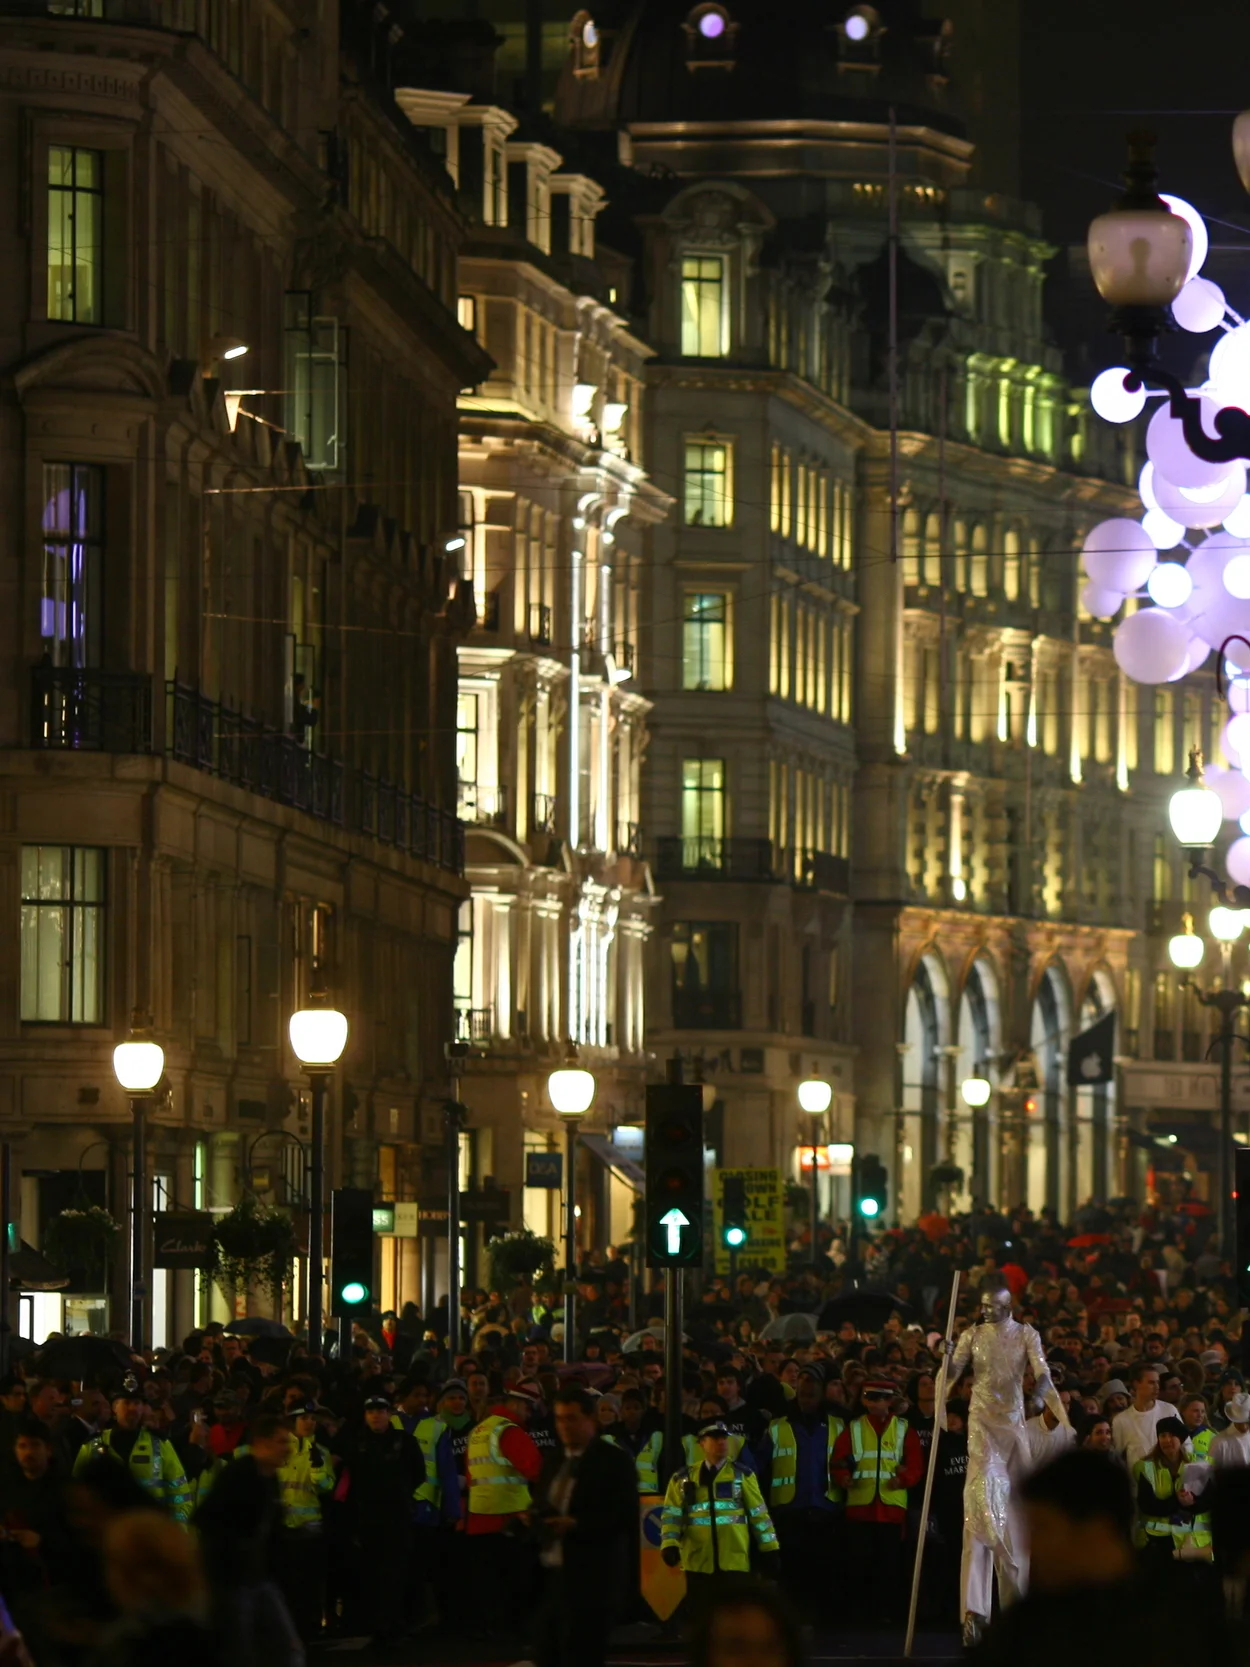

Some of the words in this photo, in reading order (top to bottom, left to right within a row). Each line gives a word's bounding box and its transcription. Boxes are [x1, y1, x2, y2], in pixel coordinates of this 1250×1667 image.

[452, 1436, 469, 1447] EVE
[950, 1455, 970, 1466] EVEN
[944, 1465, 968, 1477] MARS
